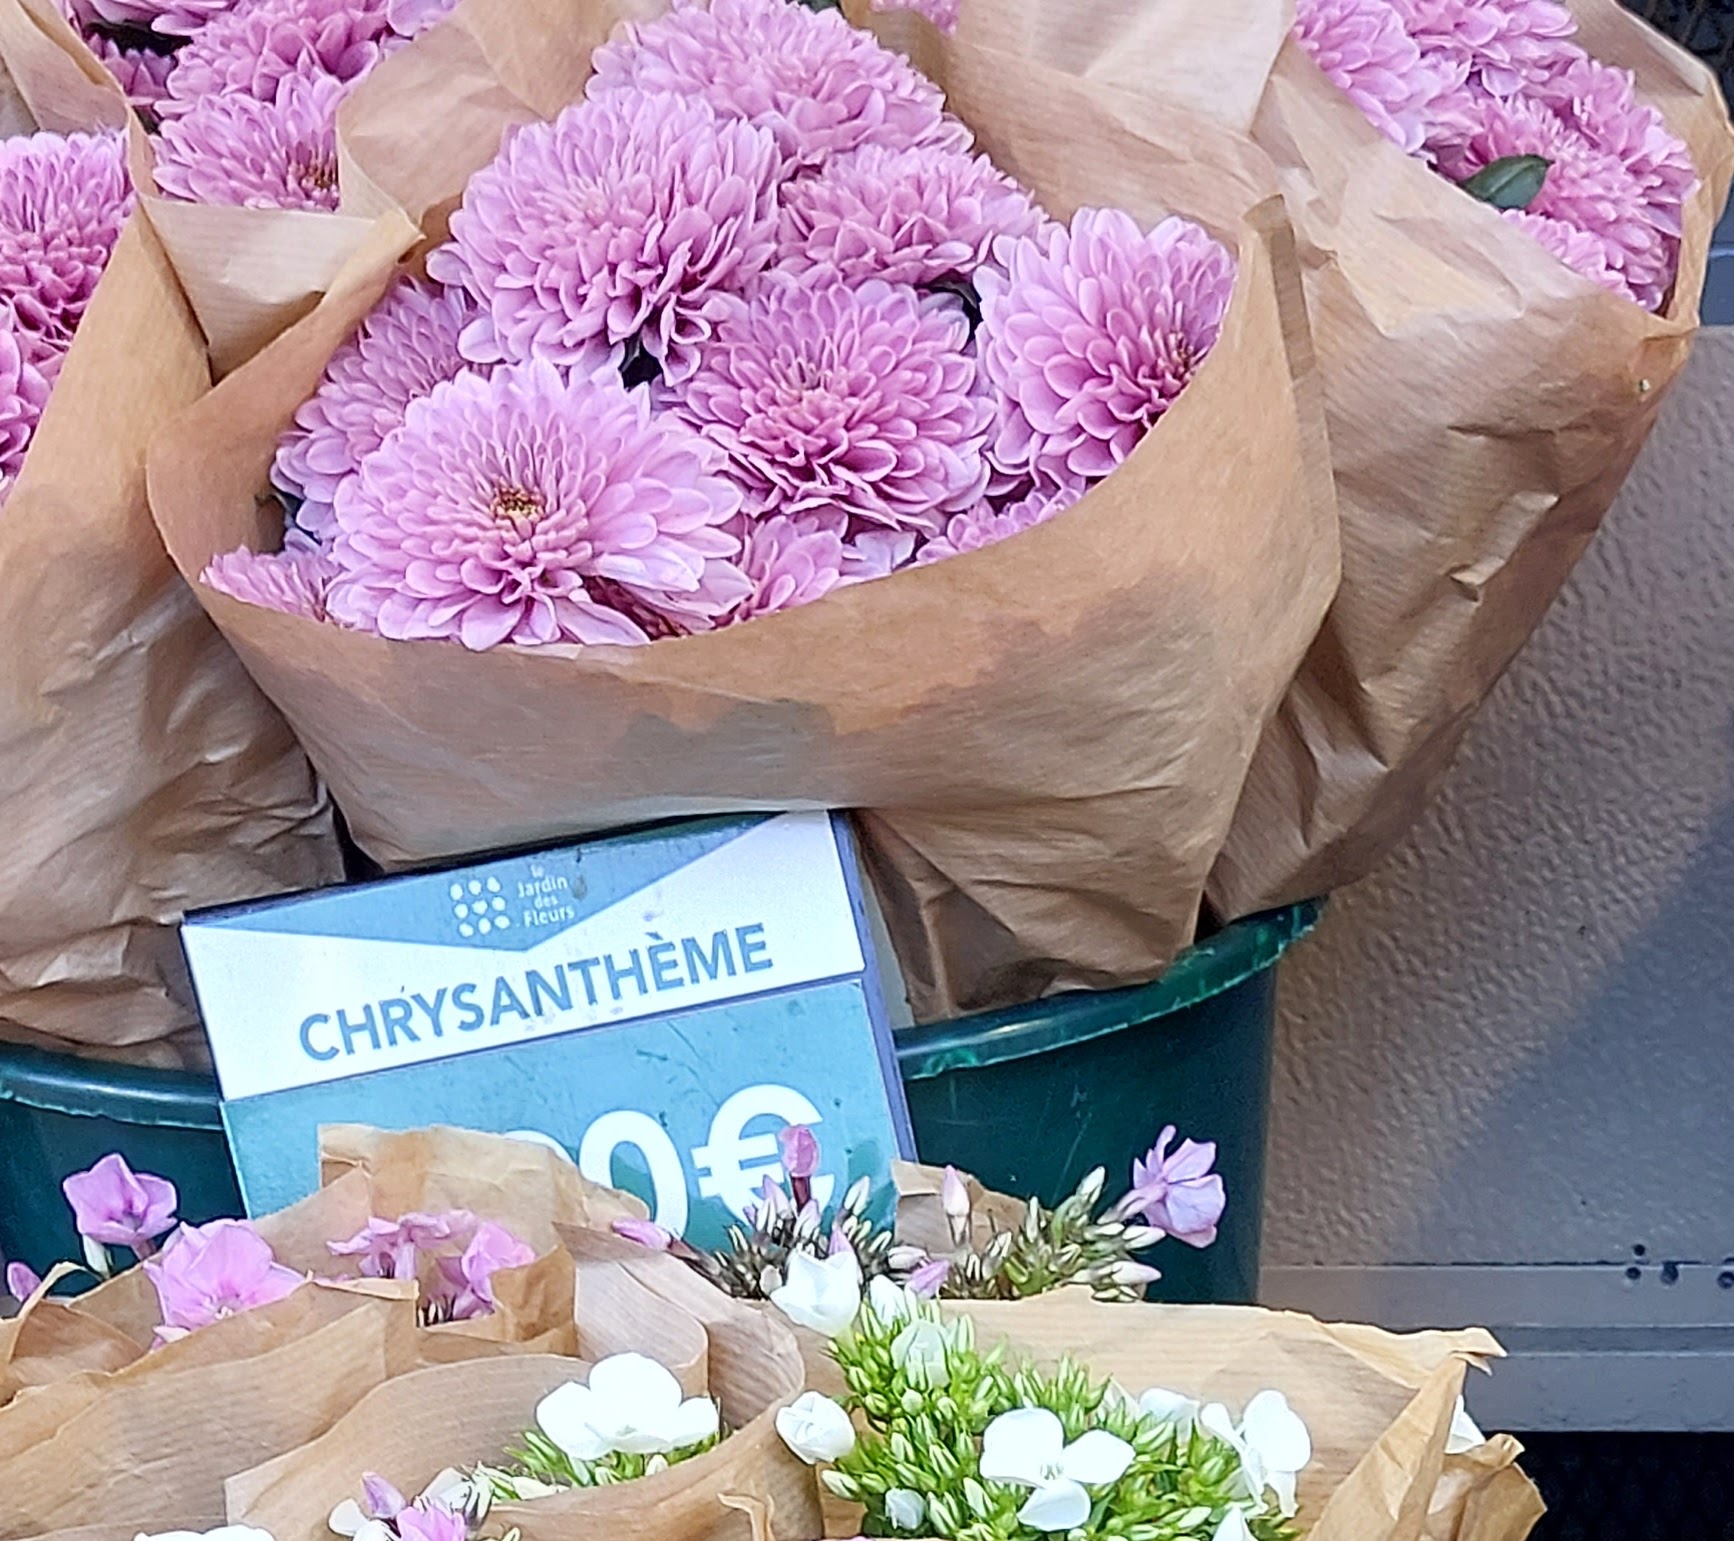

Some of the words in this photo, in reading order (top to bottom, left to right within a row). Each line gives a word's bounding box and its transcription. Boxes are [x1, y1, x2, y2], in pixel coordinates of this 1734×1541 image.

[518, 876, 568, 898] Jardin
[534, 895, 559, 909] des
[523, 906, 575, 928] Fleurs
[299, 922, 775, 1062] CHRYSANTHÈME
[503, 1083, 835, 1242] 0€
